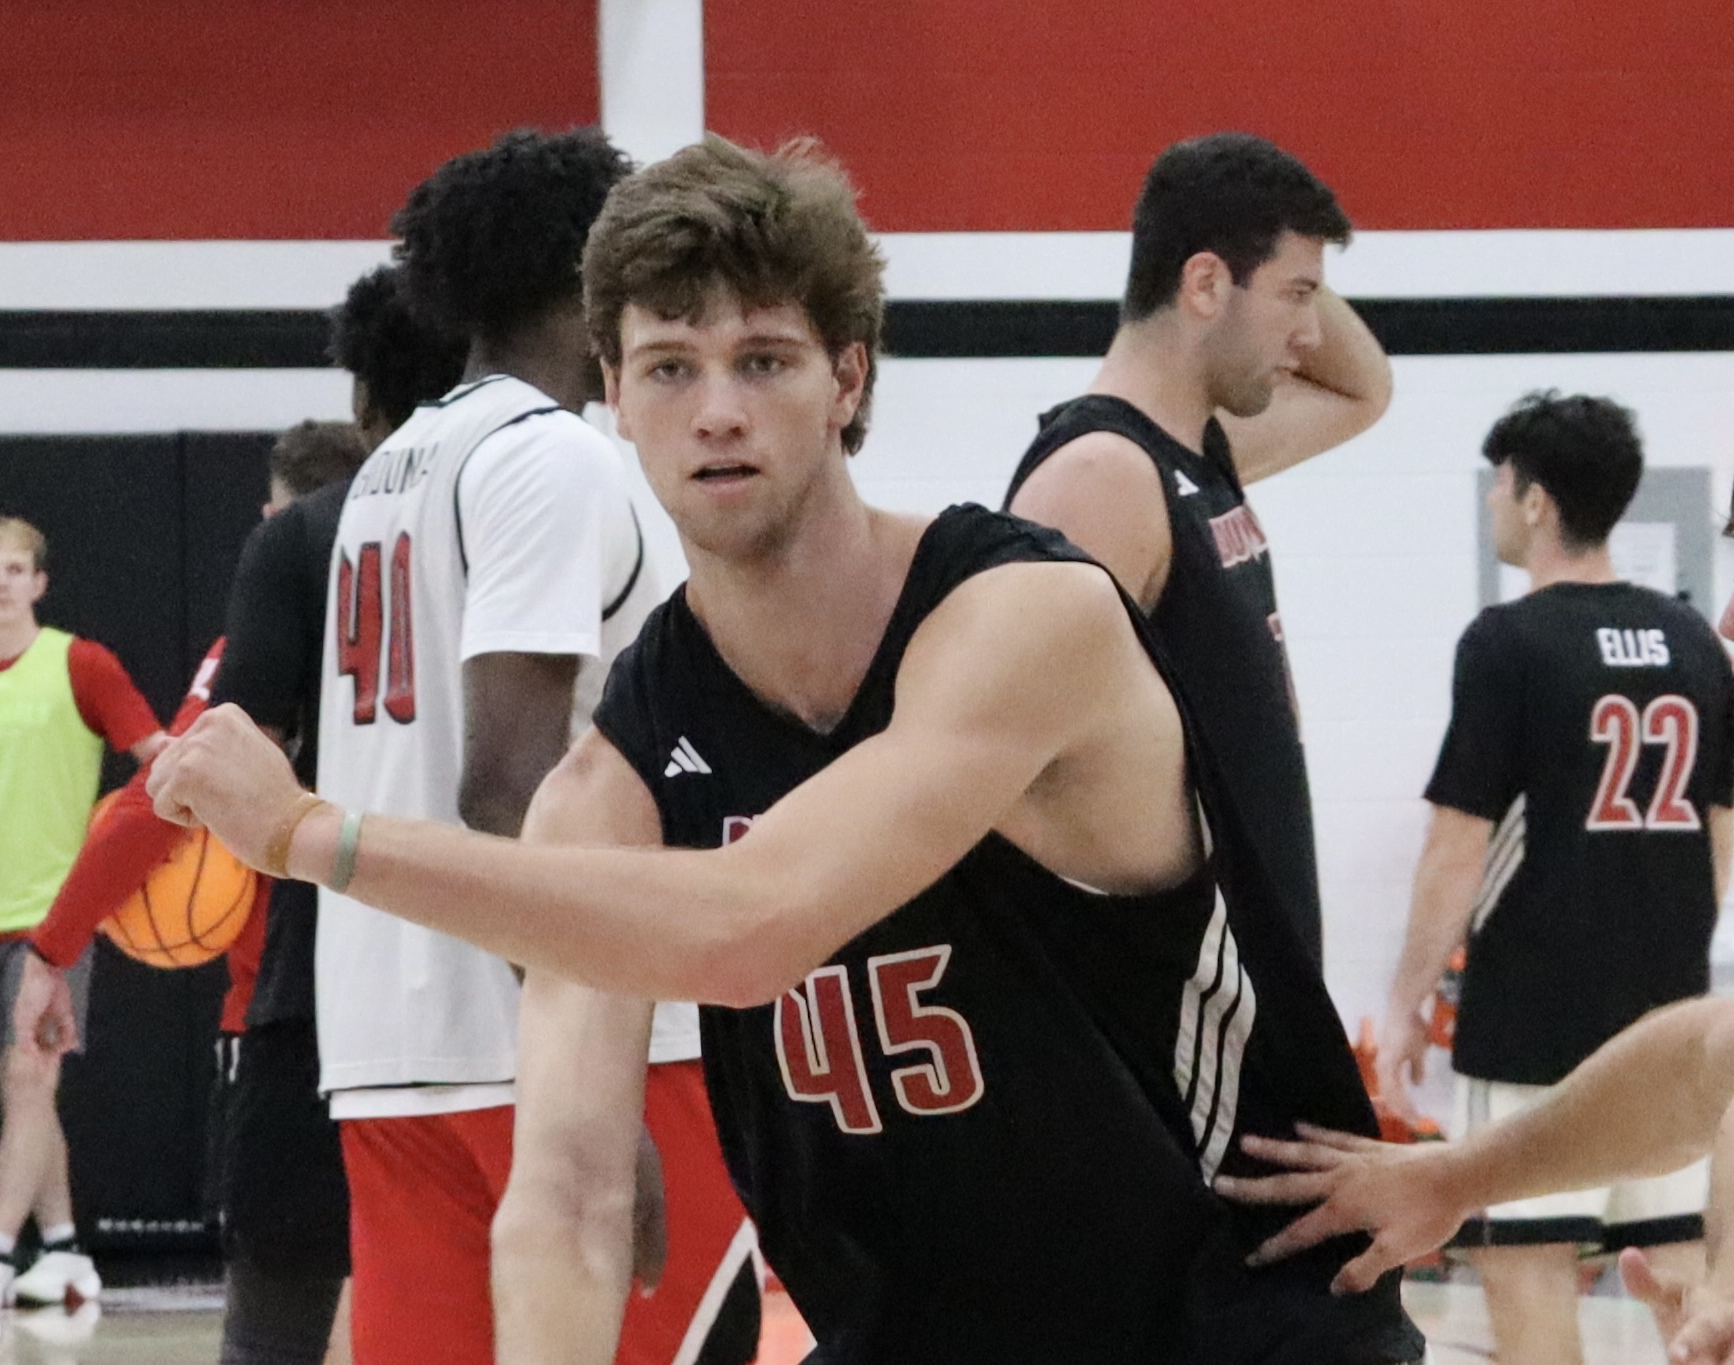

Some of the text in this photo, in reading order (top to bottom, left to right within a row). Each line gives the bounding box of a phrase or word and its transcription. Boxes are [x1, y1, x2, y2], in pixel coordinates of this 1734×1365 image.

[1595, 626, 1671, 667] ELLIS
[1584, 692, 1702, 832] 22
[773, 943, 986, 1135] 45
